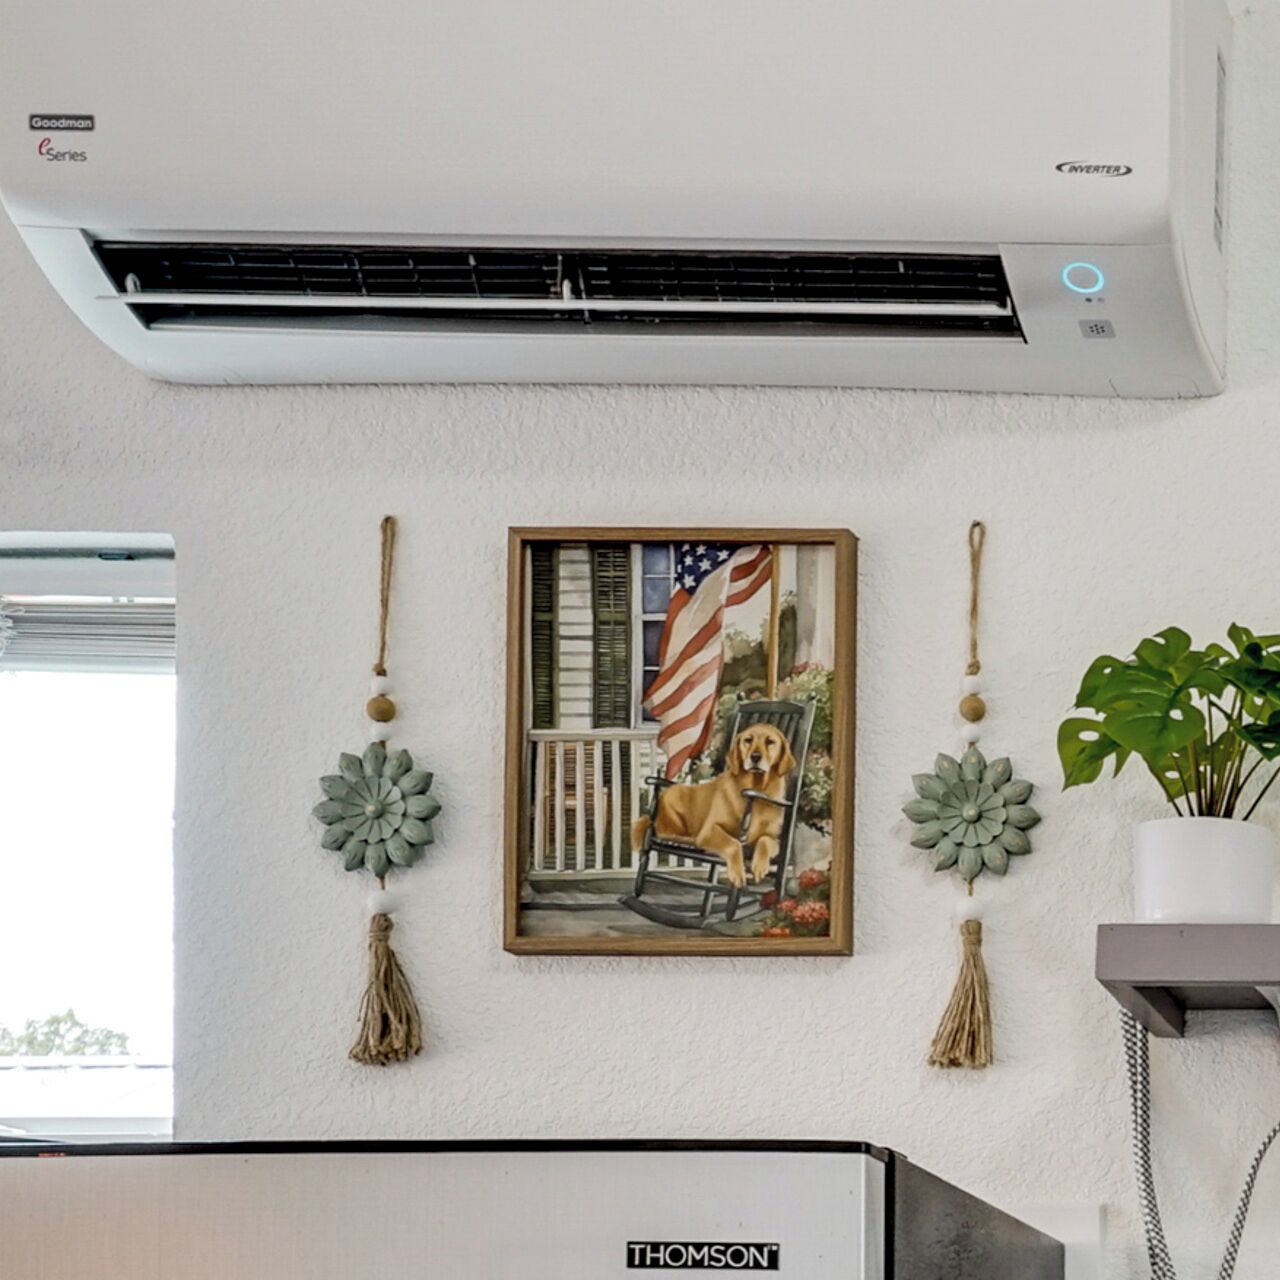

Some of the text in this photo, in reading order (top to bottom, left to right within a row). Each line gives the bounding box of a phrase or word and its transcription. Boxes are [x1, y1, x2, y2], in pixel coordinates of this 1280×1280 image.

[31, 117, 92, 129] Goodman
[1067, 164, 1121, 175] INVERTER
[629, 1243, 769, 1268] THOMSON
